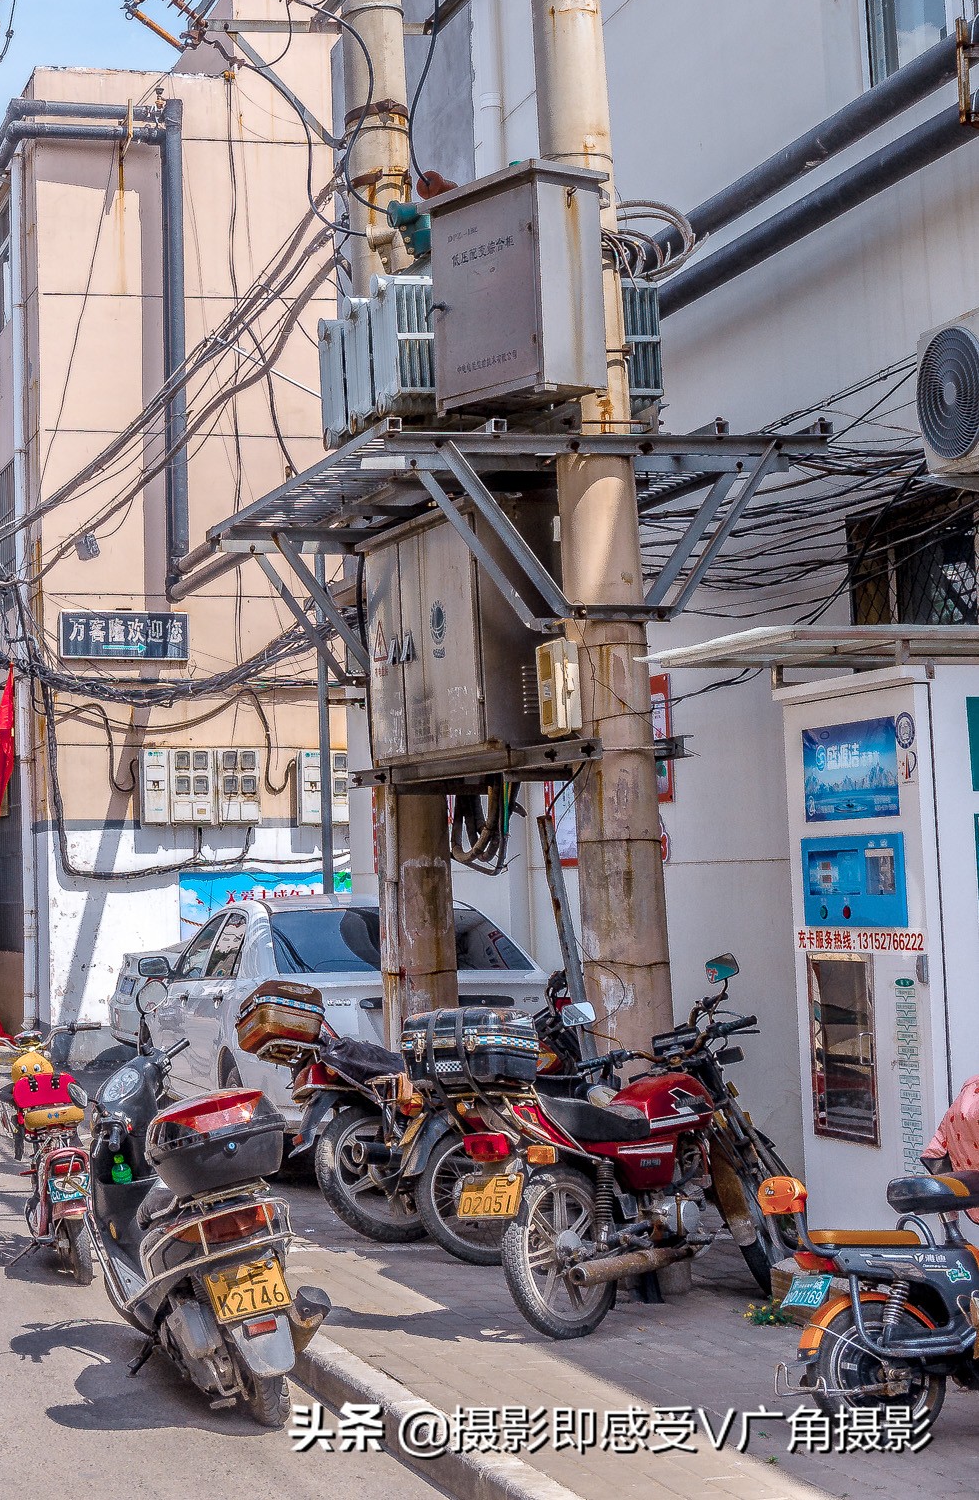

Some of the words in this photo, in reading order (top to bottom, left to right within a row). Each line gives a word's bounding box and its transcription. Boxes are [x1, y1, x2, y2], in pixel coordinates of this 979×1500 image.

[68, 617, 184, 644] 万客隆欢迎您
[462, 1194, 512, 1215] 02051
[217, 1283, 285, 1317] K2746
